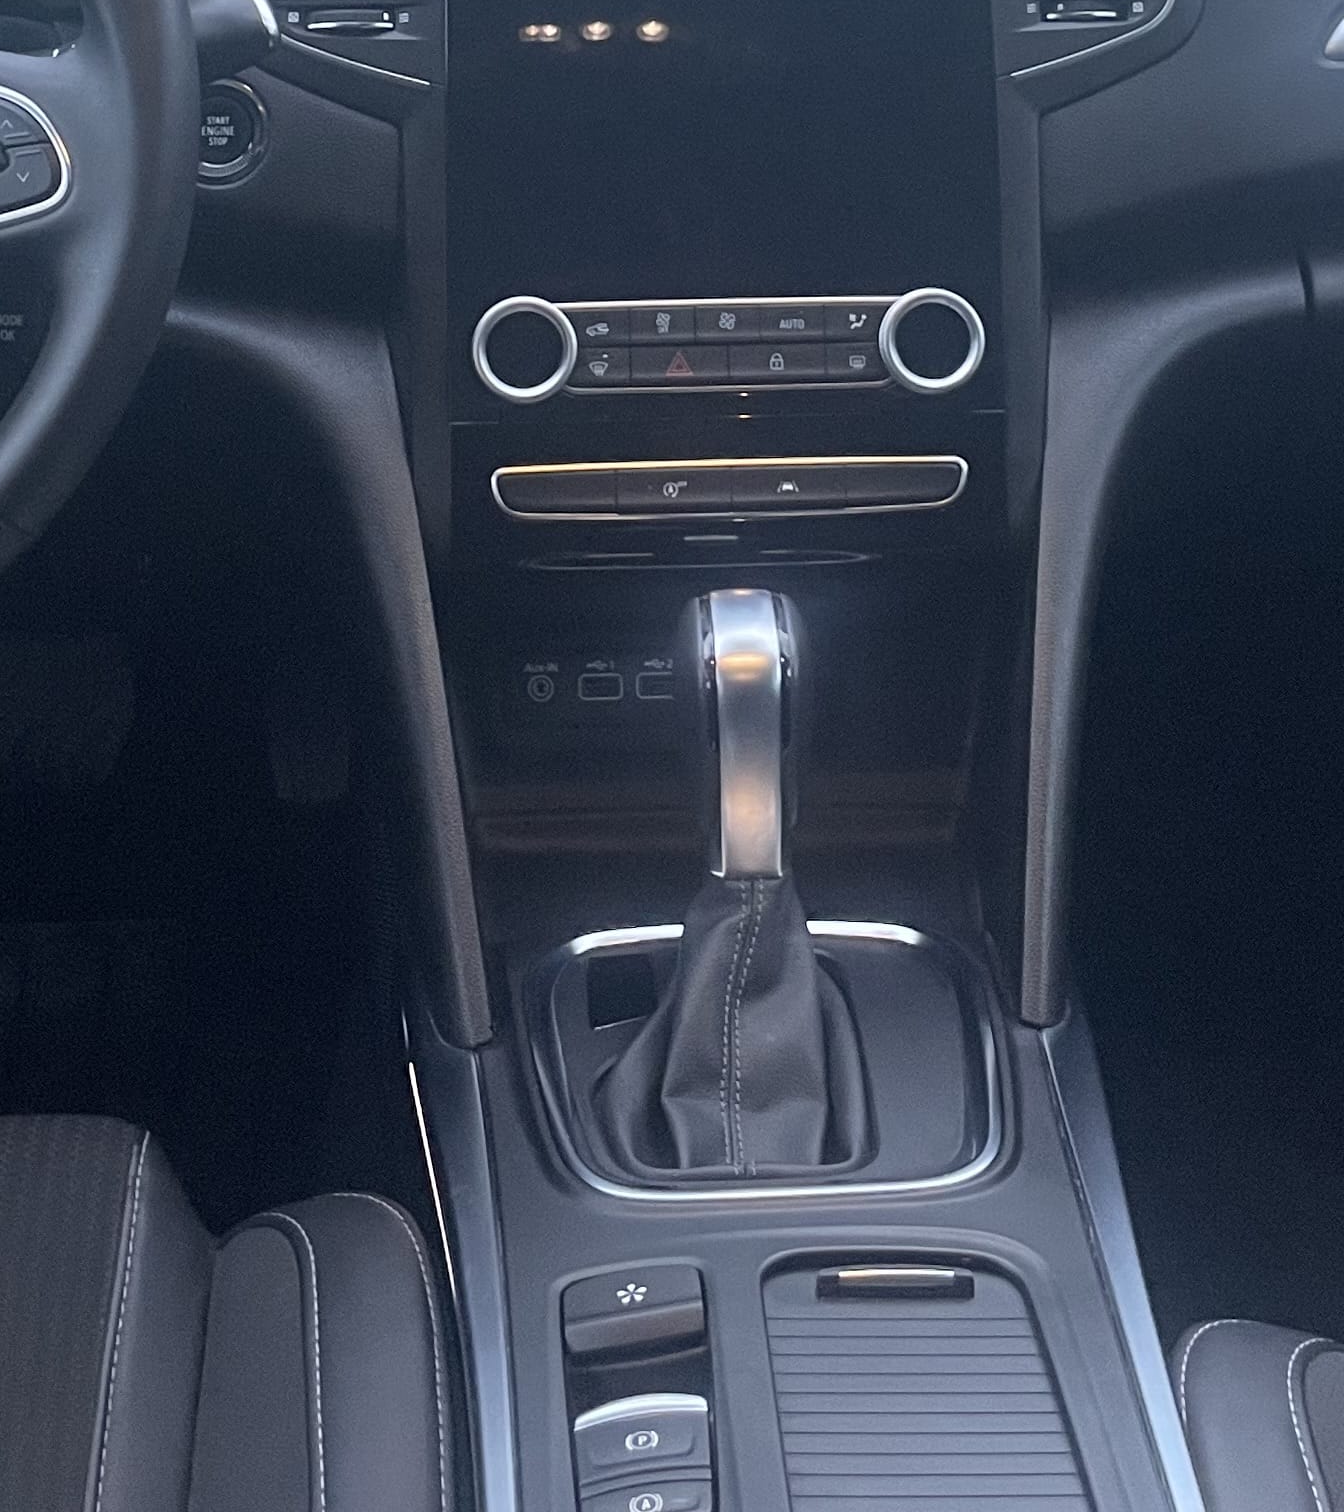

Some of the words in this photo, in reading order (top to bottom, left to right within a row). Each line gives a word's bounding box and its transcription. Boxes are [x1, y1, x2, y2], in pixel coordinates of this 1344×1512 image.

[207, 116, 230, 125] START
[201, 125, 235, 136] ENGINE
[208, 136, 228, 146] STOP
[779, 318, 806, 329] AUTO
